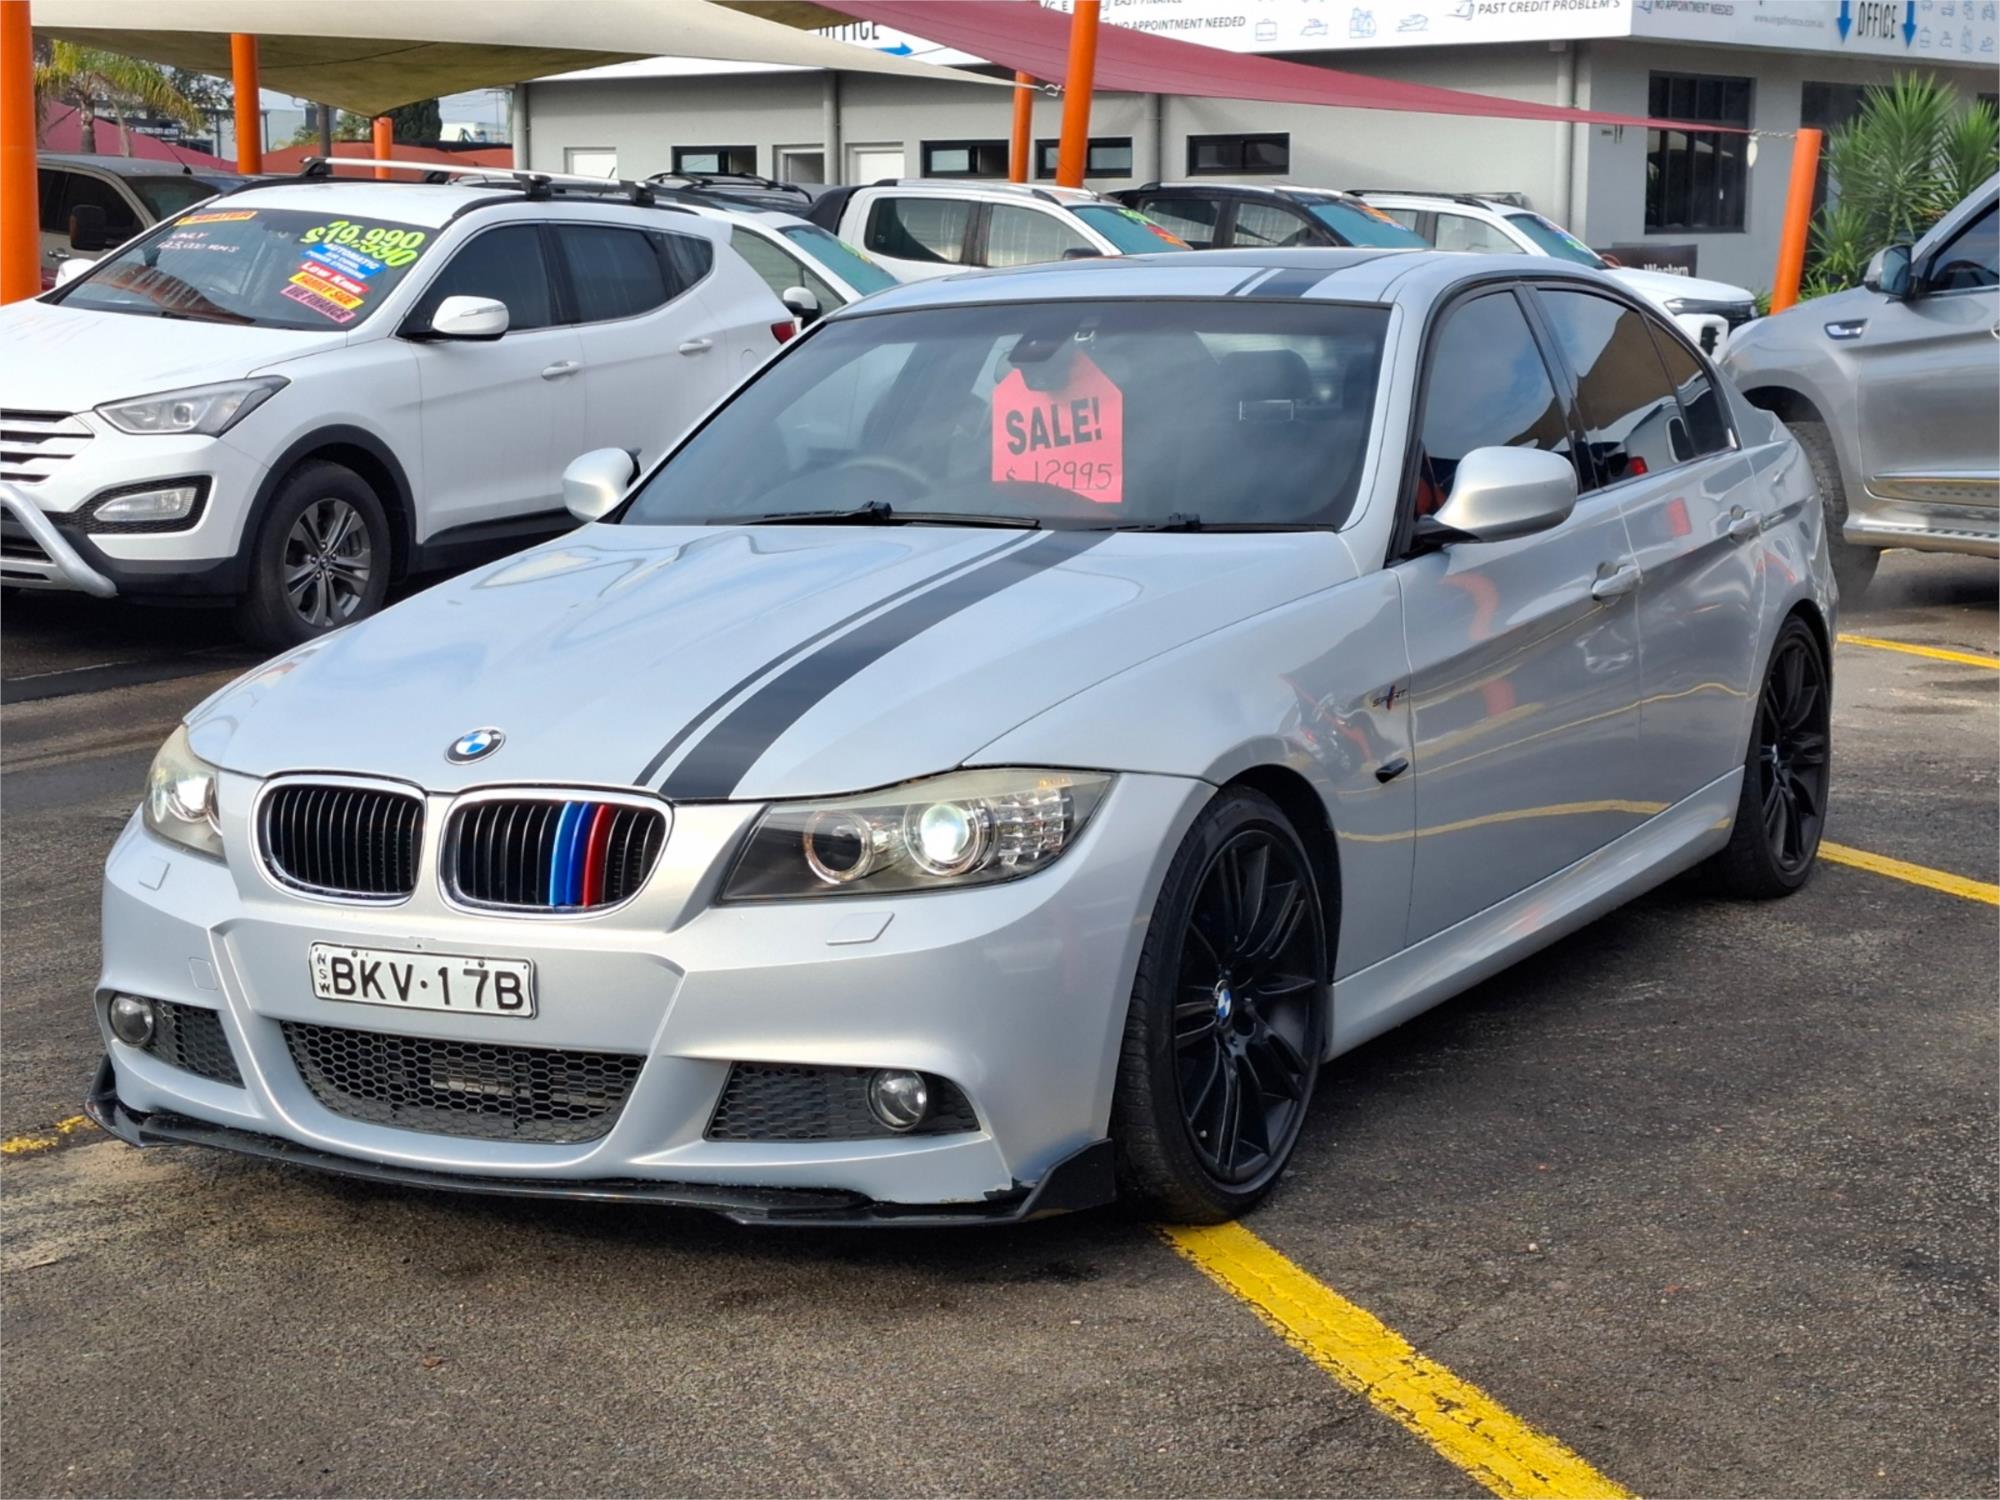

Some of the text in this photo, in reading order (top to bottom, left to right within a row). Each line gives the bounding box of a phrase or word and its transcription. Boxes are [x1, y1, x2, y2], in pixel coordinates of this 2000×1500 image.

[1479, 3, 1506, 14] PAST
[1508, 1, 1550, 13] CREDIT
[1857, 1, 1897, 39] OFFICE
[1132, 18, 1204, 31] APPOINTMENT
[1205, 16, 1246, 28] NEEDED
[1006, 397, 1102, 455] SALE!
